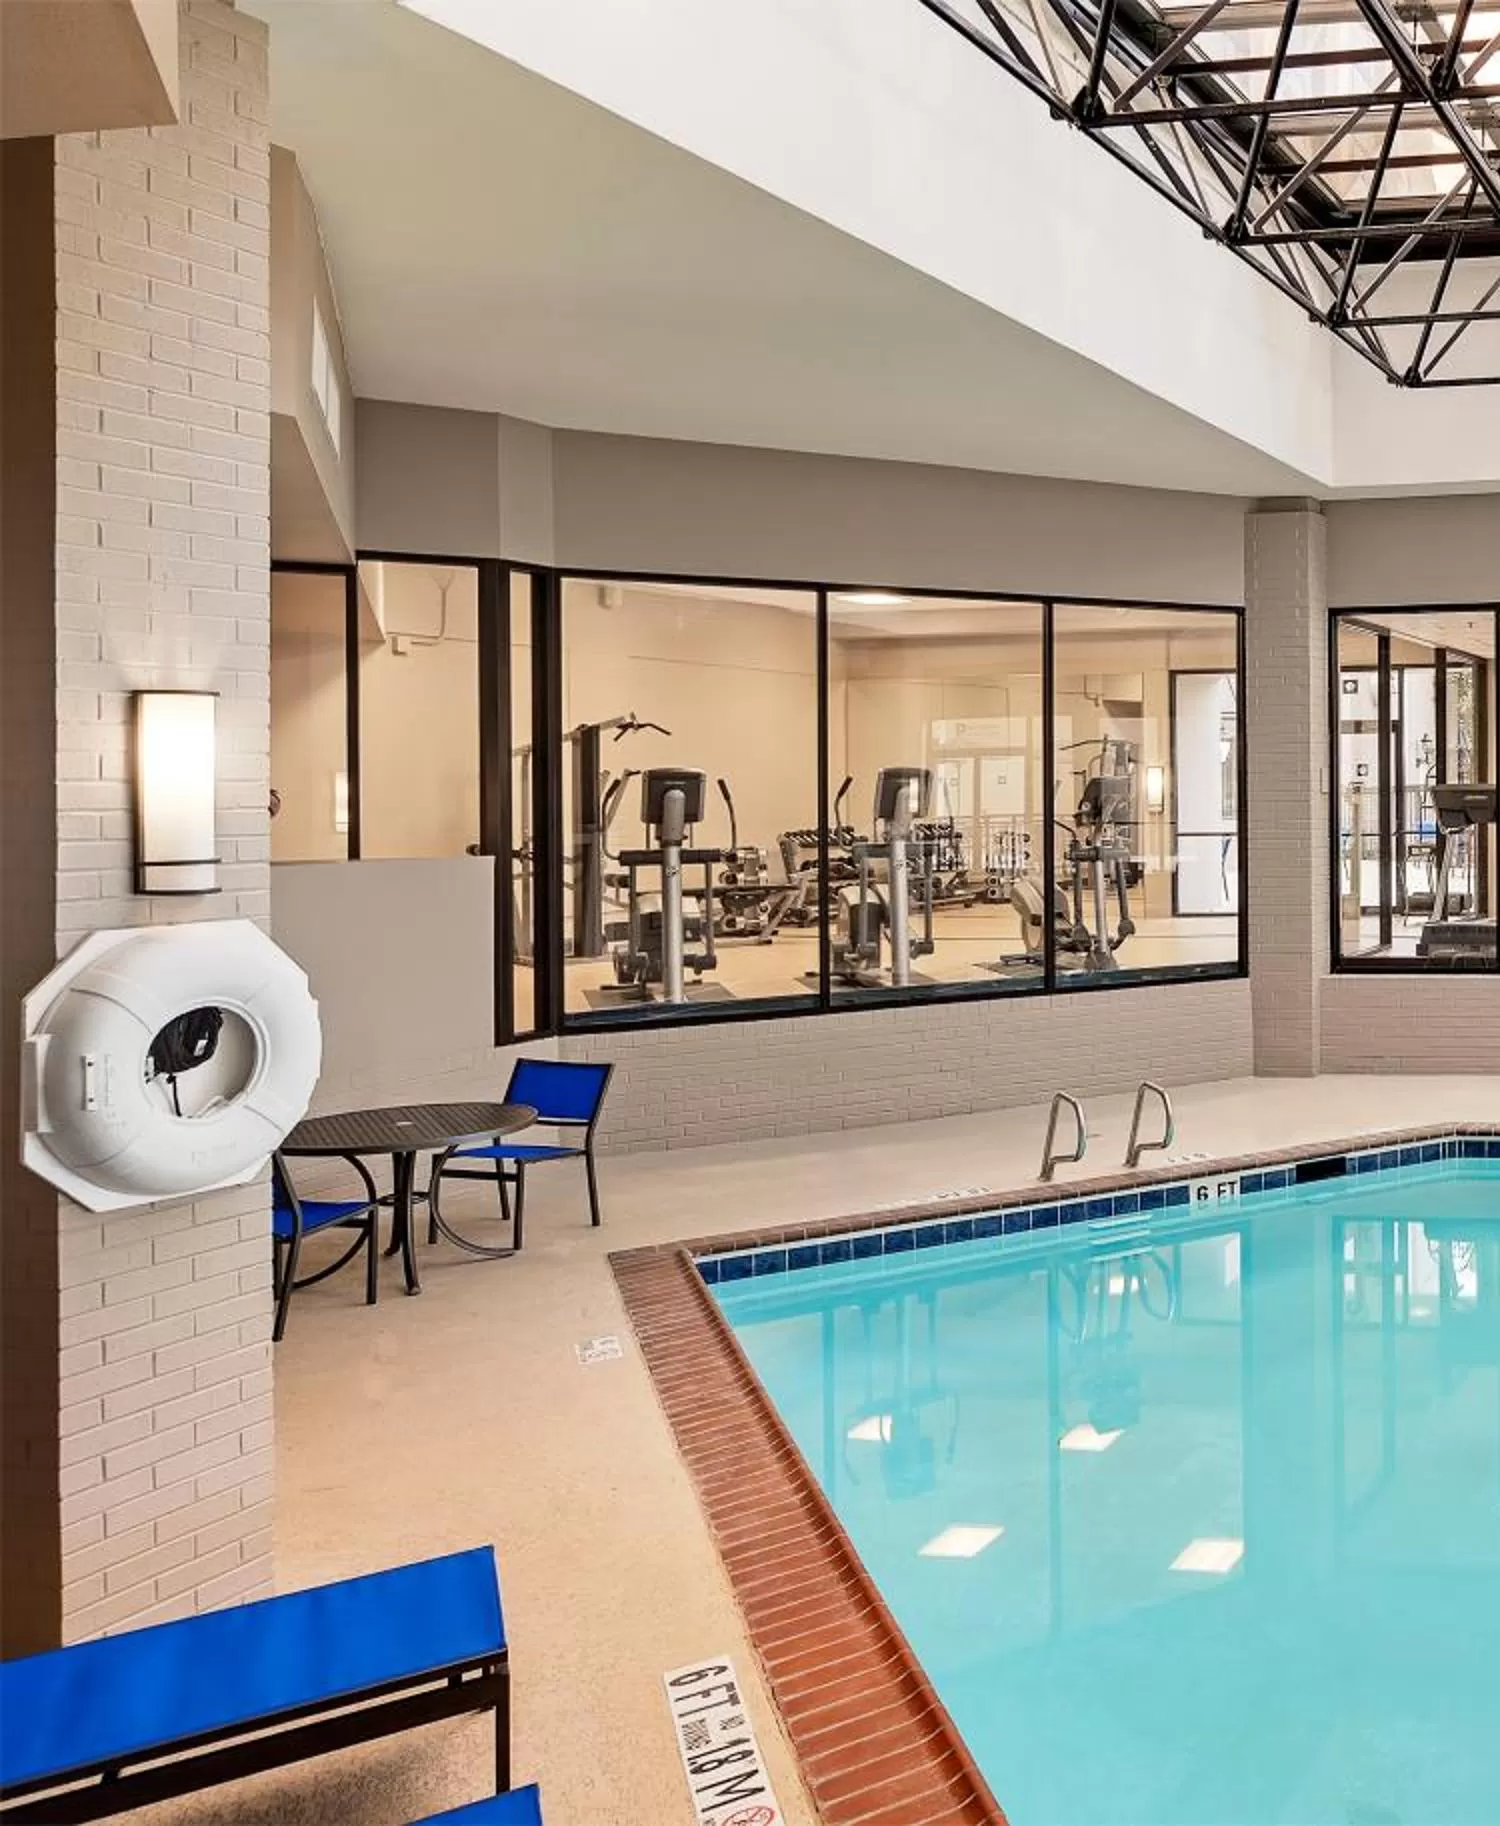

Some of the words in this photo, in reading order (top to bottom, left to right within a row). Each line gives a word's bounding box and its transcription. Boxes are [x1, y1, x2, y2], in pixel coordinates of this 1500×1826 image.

[1197, 1185, 1209, 1201] 6
[1217, 1181, 1237, 1198] FT
[669, 1665, 728, 1687] 6
[674, 1682, 741, 1718] FT
